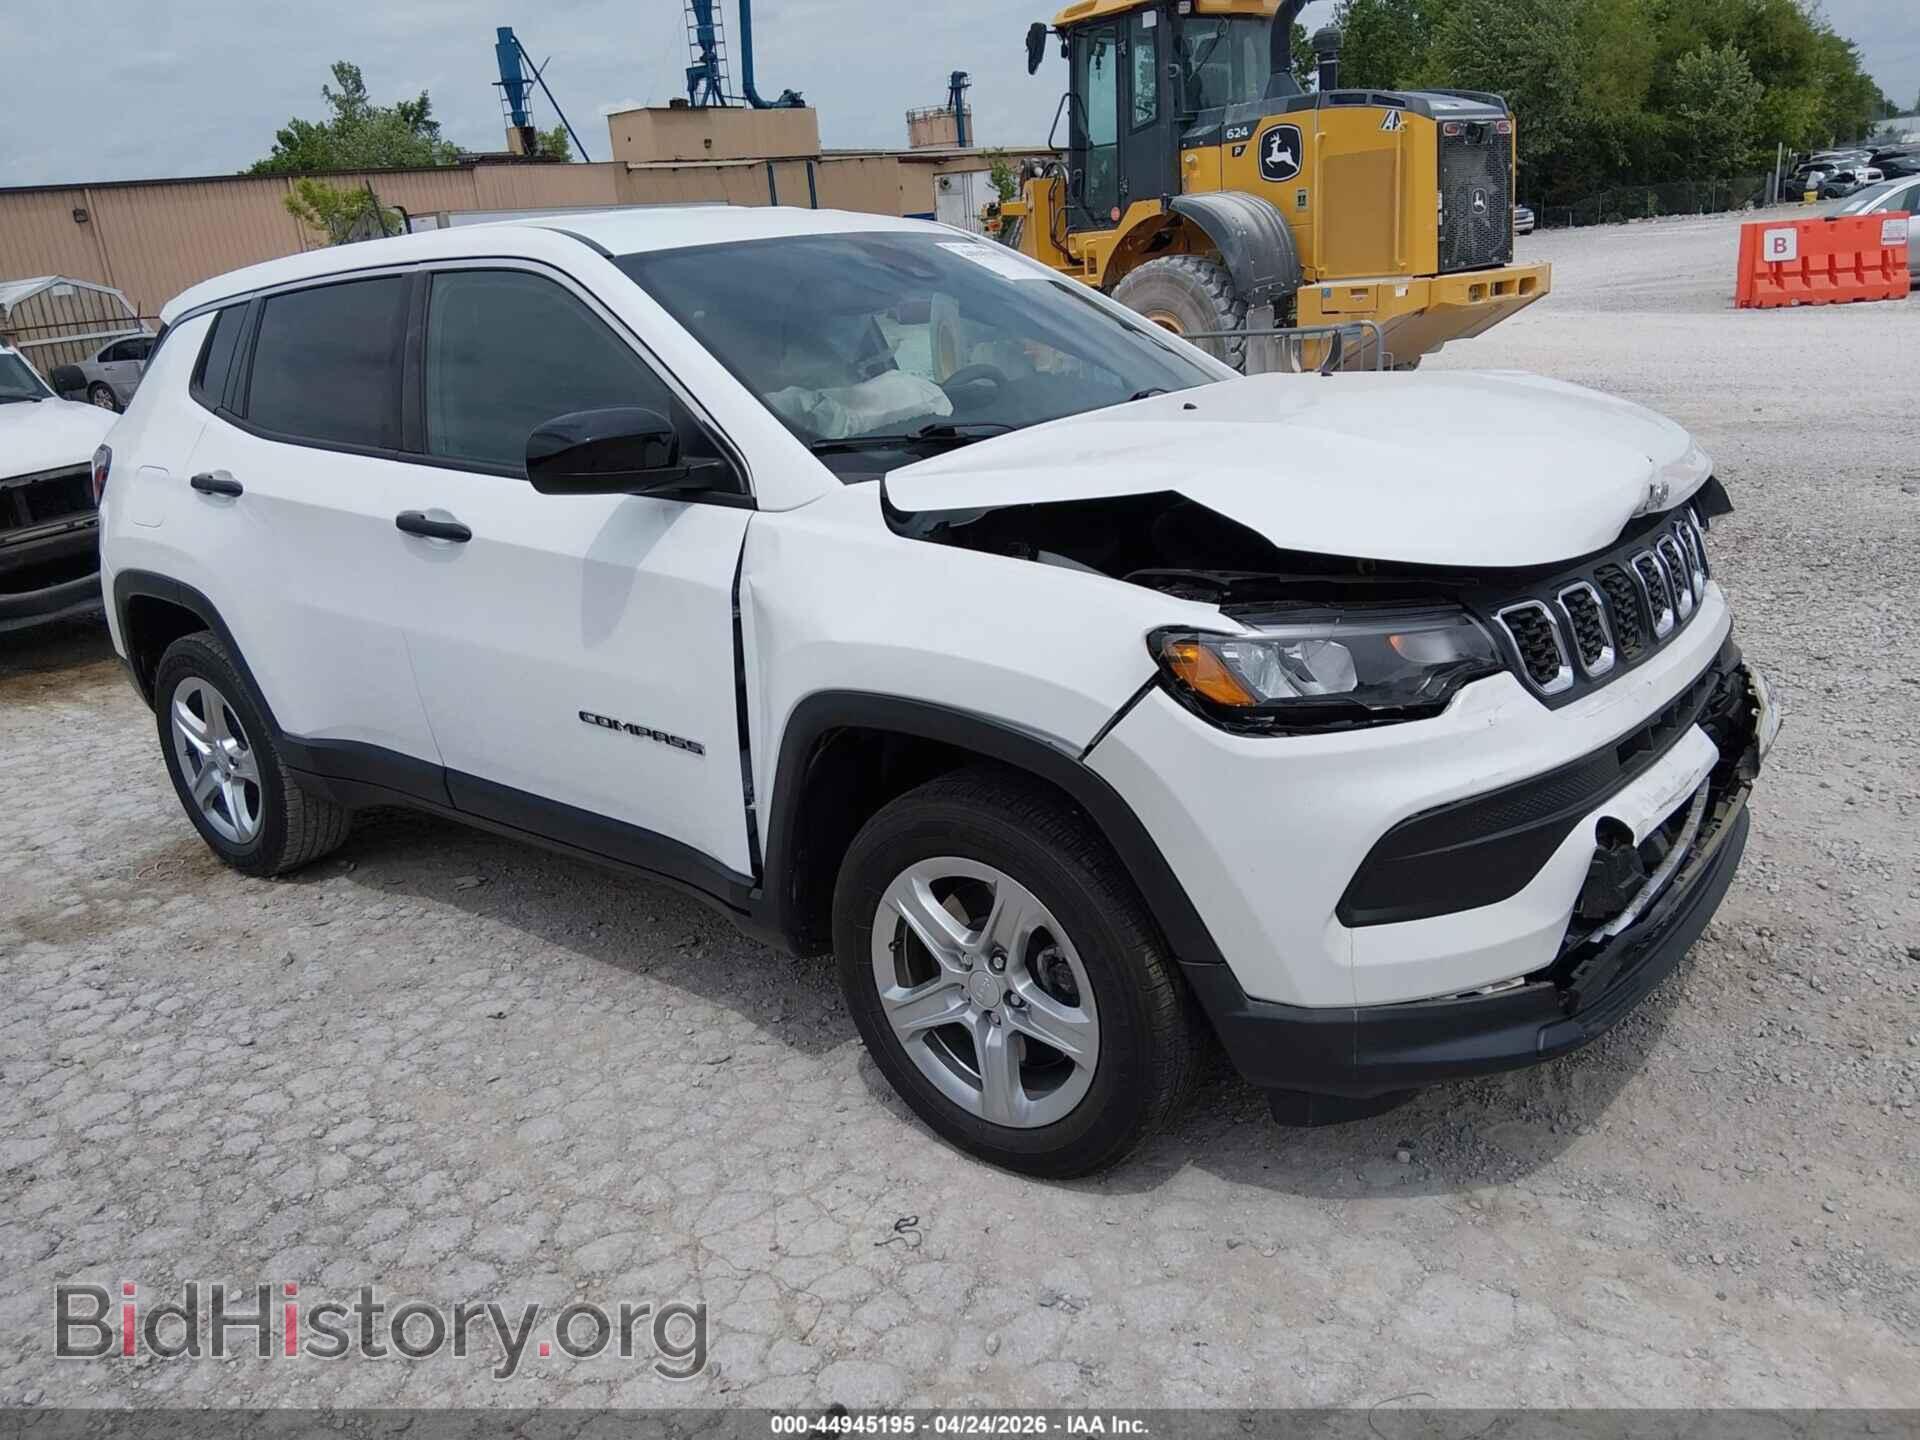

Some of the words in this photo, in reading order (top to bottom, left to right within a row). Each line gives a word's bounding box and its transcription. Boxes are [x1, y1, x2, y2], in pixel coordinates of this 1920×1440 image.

[1226, 126, 1249, 139] 624
[1773, 237, 1788, 253] B
[578, 710, 705, 755] COMPASS
